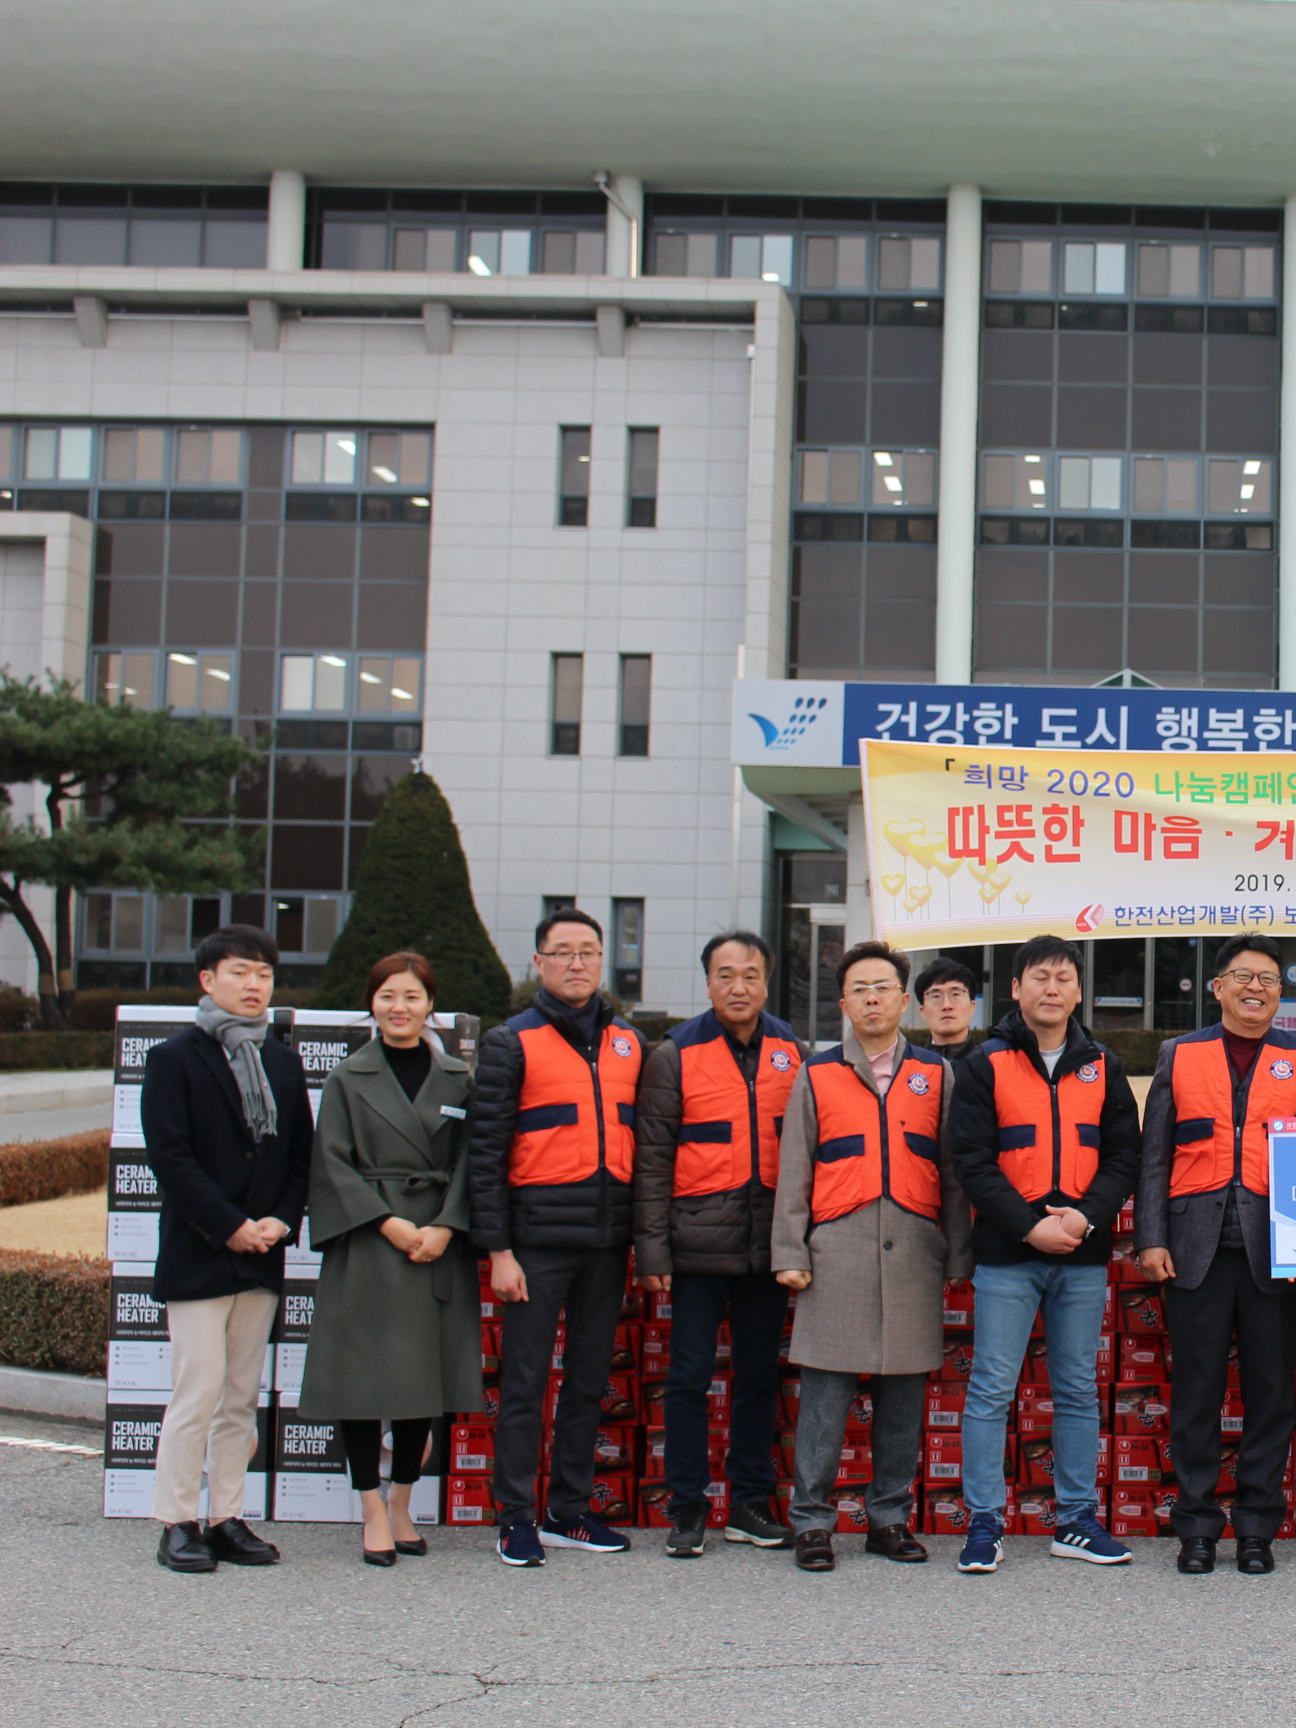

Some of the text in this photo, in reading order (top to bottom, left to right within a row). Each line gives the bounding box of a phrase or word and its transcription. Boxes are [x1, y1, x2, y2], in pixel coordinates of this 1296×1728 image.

[875, 701, 1018, 748] 건강한
[1035, 705, 1129, 750] 도시
[1047, 769, 1135, 798] 2020
[947, 803, 1085, 866] 따뜻한
[1114, 809, 1203, 861] 마음
[1234, 874, 1291, 892] 2019.
[1114, 904, 1275, 927] 한전산업개발(주)
[116, 1180, 158, 1194] HEATER
[116, 1308, 158, 1323] HEATER
[112, 1421, 162, 1437] CERAMIC
[284, 1425, 334, 1440] CERAMIC
[112, 1436, 154, 1451] HEATER
[284, 1440, 326, 1454] HEATER
